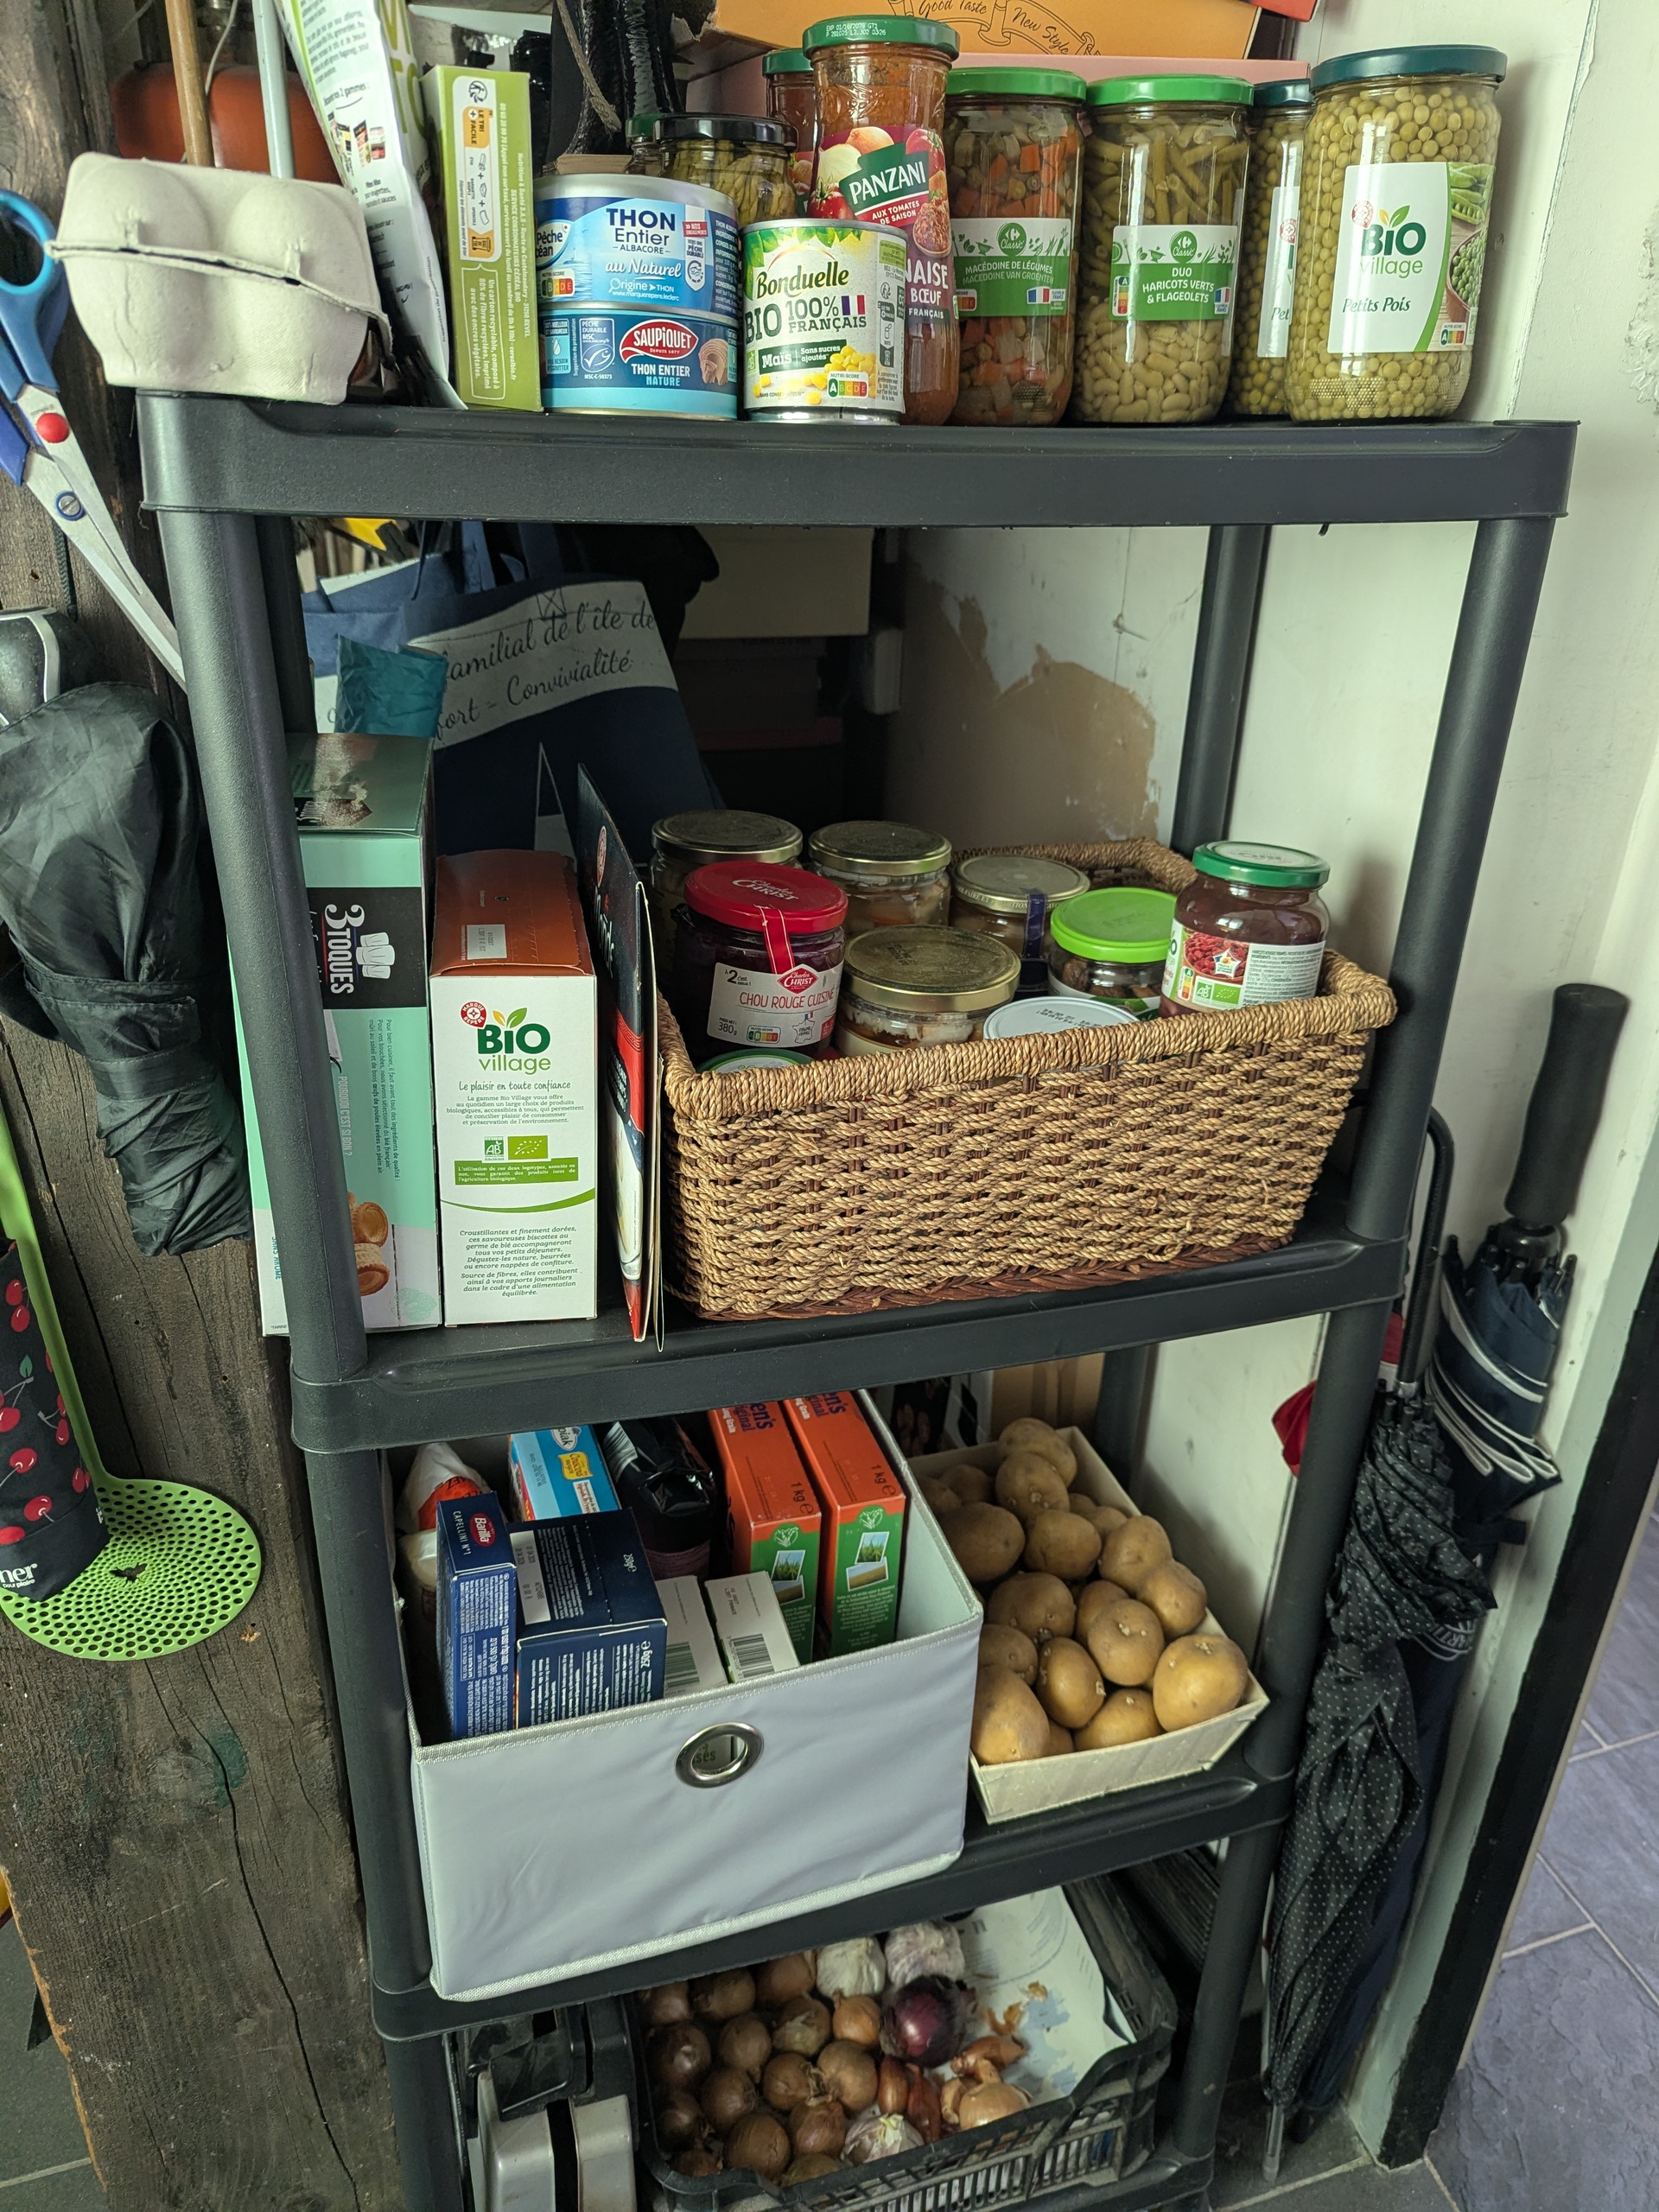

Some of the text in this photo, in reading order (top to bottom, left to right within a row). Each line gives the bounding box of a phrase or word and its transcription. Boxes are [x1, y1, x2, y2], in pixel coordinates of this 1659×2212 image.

[1014, 7, 1069, 54] New Style
[478, 110, 484, 118] LE
[849, 161, 926, 205] PANZANI
[872, 200, 920, 220] AUX TOMATES
[880, 210, 917, 226] DE SAISON
[606, 208, 676, 232] THON
[537, 228, 563, 245] Pêche
[615, 228, 670, 246] Entier
[620, 245, 664, 255] ALBACORE
[606, 257, 682, 277] au Naturel
[965, 260, 1052, 275] MACÉDOINE DE LÉGUMES
[1172, 267, 1192, 277] DUO
[1360, 257, 1424, 278] village
[487, 279, 495, 289] Un
[608, 277, 675, 293] Origine THON
[756, 261, 849, 299] Bonduelle
[1021, 271, 1054, 284] GROENTEN
[1142, 279, 1215, 294] HARICOTS VERTS
[480, 292, 487, 301] de
[911, 288, 942, 305] BŒUF
[1147, 291, 1210, 304] & FLAGEOLETS
[1343, 296, 1411, 314] Petits Pois
[745, 296, 840, 345] BIO 100%
[908, 308, 944, 320] FRANÇAIS
[582, 320, 600, 328] PÊCHE
[788, 315, 868, 334] FRANÇAIS
[480, 325, 489, 359] recyclées,
[487, 315, 498, 353] recyclable,
[800, 345, 842, 355] Sans sucres
[470, 343, 482, 378] végétales.
[490, 353, 499, 384] composé
[761, 351, 792, 369] Maïs
[631, 363, 690, 378] THON ENTIER
[645, 376, 681, 387] NATURE
[445, 618, 536, 680] amilial
[543, 610, 571, 646] de
[576, 601, 624, 634] l'île
[507, 647, 632, 706] Convivialité
[733, 880, 799, 900] CHRIST
[727, 969, 737, 984] 2
[784, 976, 813, 988] CHRIST
[462, 1002, 485, 1012] MARQUE
[739, 991, 769, 1007] CHOU
[771, 995, 805, 1009] ROUGE
[463, 1015, 485, 1025] REPÈRE
[718, 1022, 737, 1036] 380g
[478, 1054, 551, 1076] village
[387, 1072, 396, 1083] faut
[337, 1076, 349, 1109] POURQUOI
[459, 1080, 468, 1091] Le
[470, 1080, 494, 1094] plaisir
[508, 1081, 532, 1090] toute
[533, 1080, 571, 1092] confiance
[339, 1109, 351, 1128] C'EST
[342, 1136, 353, 1151] BON
[391, 1122, 399, 1151] ingrédients
[392, 1160, 401, 1179] qualité
[874, 1471, 887, 1485] kg
[792, 1490, 806, 1503] kg
[453, 1510, 472, 1555] CAPELLINI N°1
[474, 1517, 491, 1542] Barilla
